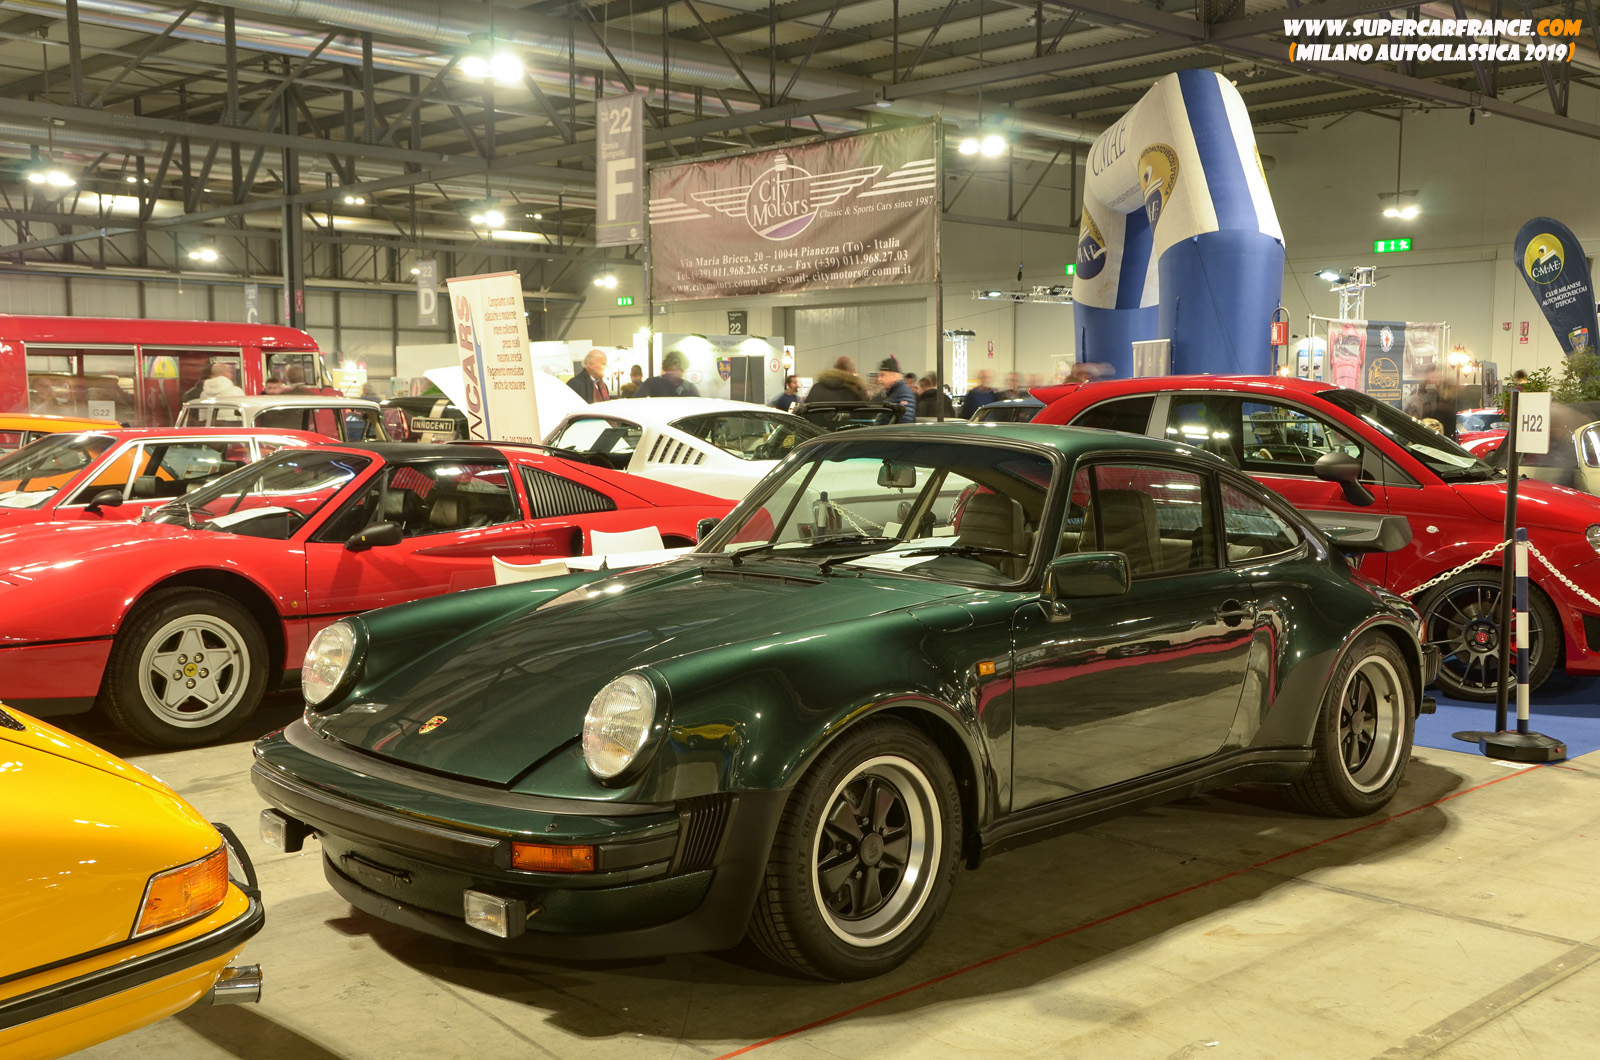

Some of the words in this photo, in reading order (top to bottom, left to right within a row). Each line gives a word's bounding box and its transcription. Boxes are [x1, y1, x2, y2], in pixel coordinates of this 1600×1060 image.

[609, 107, 632, 135] 22
[607, 158, 636, 220] F
[759, 178, 790, 206] City
[752, 196, 809, 227] Motors
[820, 206, 843, 218] Classic
[844, 205, 851, 215] &
[853, 202, 874, 216] Sports
[876, 201, 893, 211] Cars
[894, 200, 913, 209] since
[680, 259, 693, 268] Via
[696, 257, 720, 267] Maria
[723, 253, 752, 265] Bricca,
[754, 252, 764, 261] 20
[774, 248, 798, 260] 10044
[801, 244, 840, 257] Pianezza
[842, 241, 864, 254] (To)
[874, 238, 900, 250] Italia
[422, 266, 432, 277] 22
[676, 271, 691, 281] Tel.
[713, 263, 768, 277] 011.968.26.55
[770, 264, 785, 273] r.a.
[796, 260, 812, 270] Fax
[814, 256, 840, 269] (+39)
[843, 250, 909, 265] 011.968.27.03
[671, 277, 767, 293] www.citymotors.comm.it
[777, 274, 810, 284] e-mail:
[812, 264, 912, 283] citymotors@comm.it
[1545, 288, 1558, 298] CLUB
[1558, 281, 1582, 294] MILANESE
[420, 288, 436, 315] D
[1541, 286, 1588, 306] AUTOMOTOVEICOLI
[1555, 297, 1577, 309] D'EPOCA
[730, 323, 741, 335] 22
[92, 409, 110, 417] G22
[1521, 414, 1543, 433] H22
